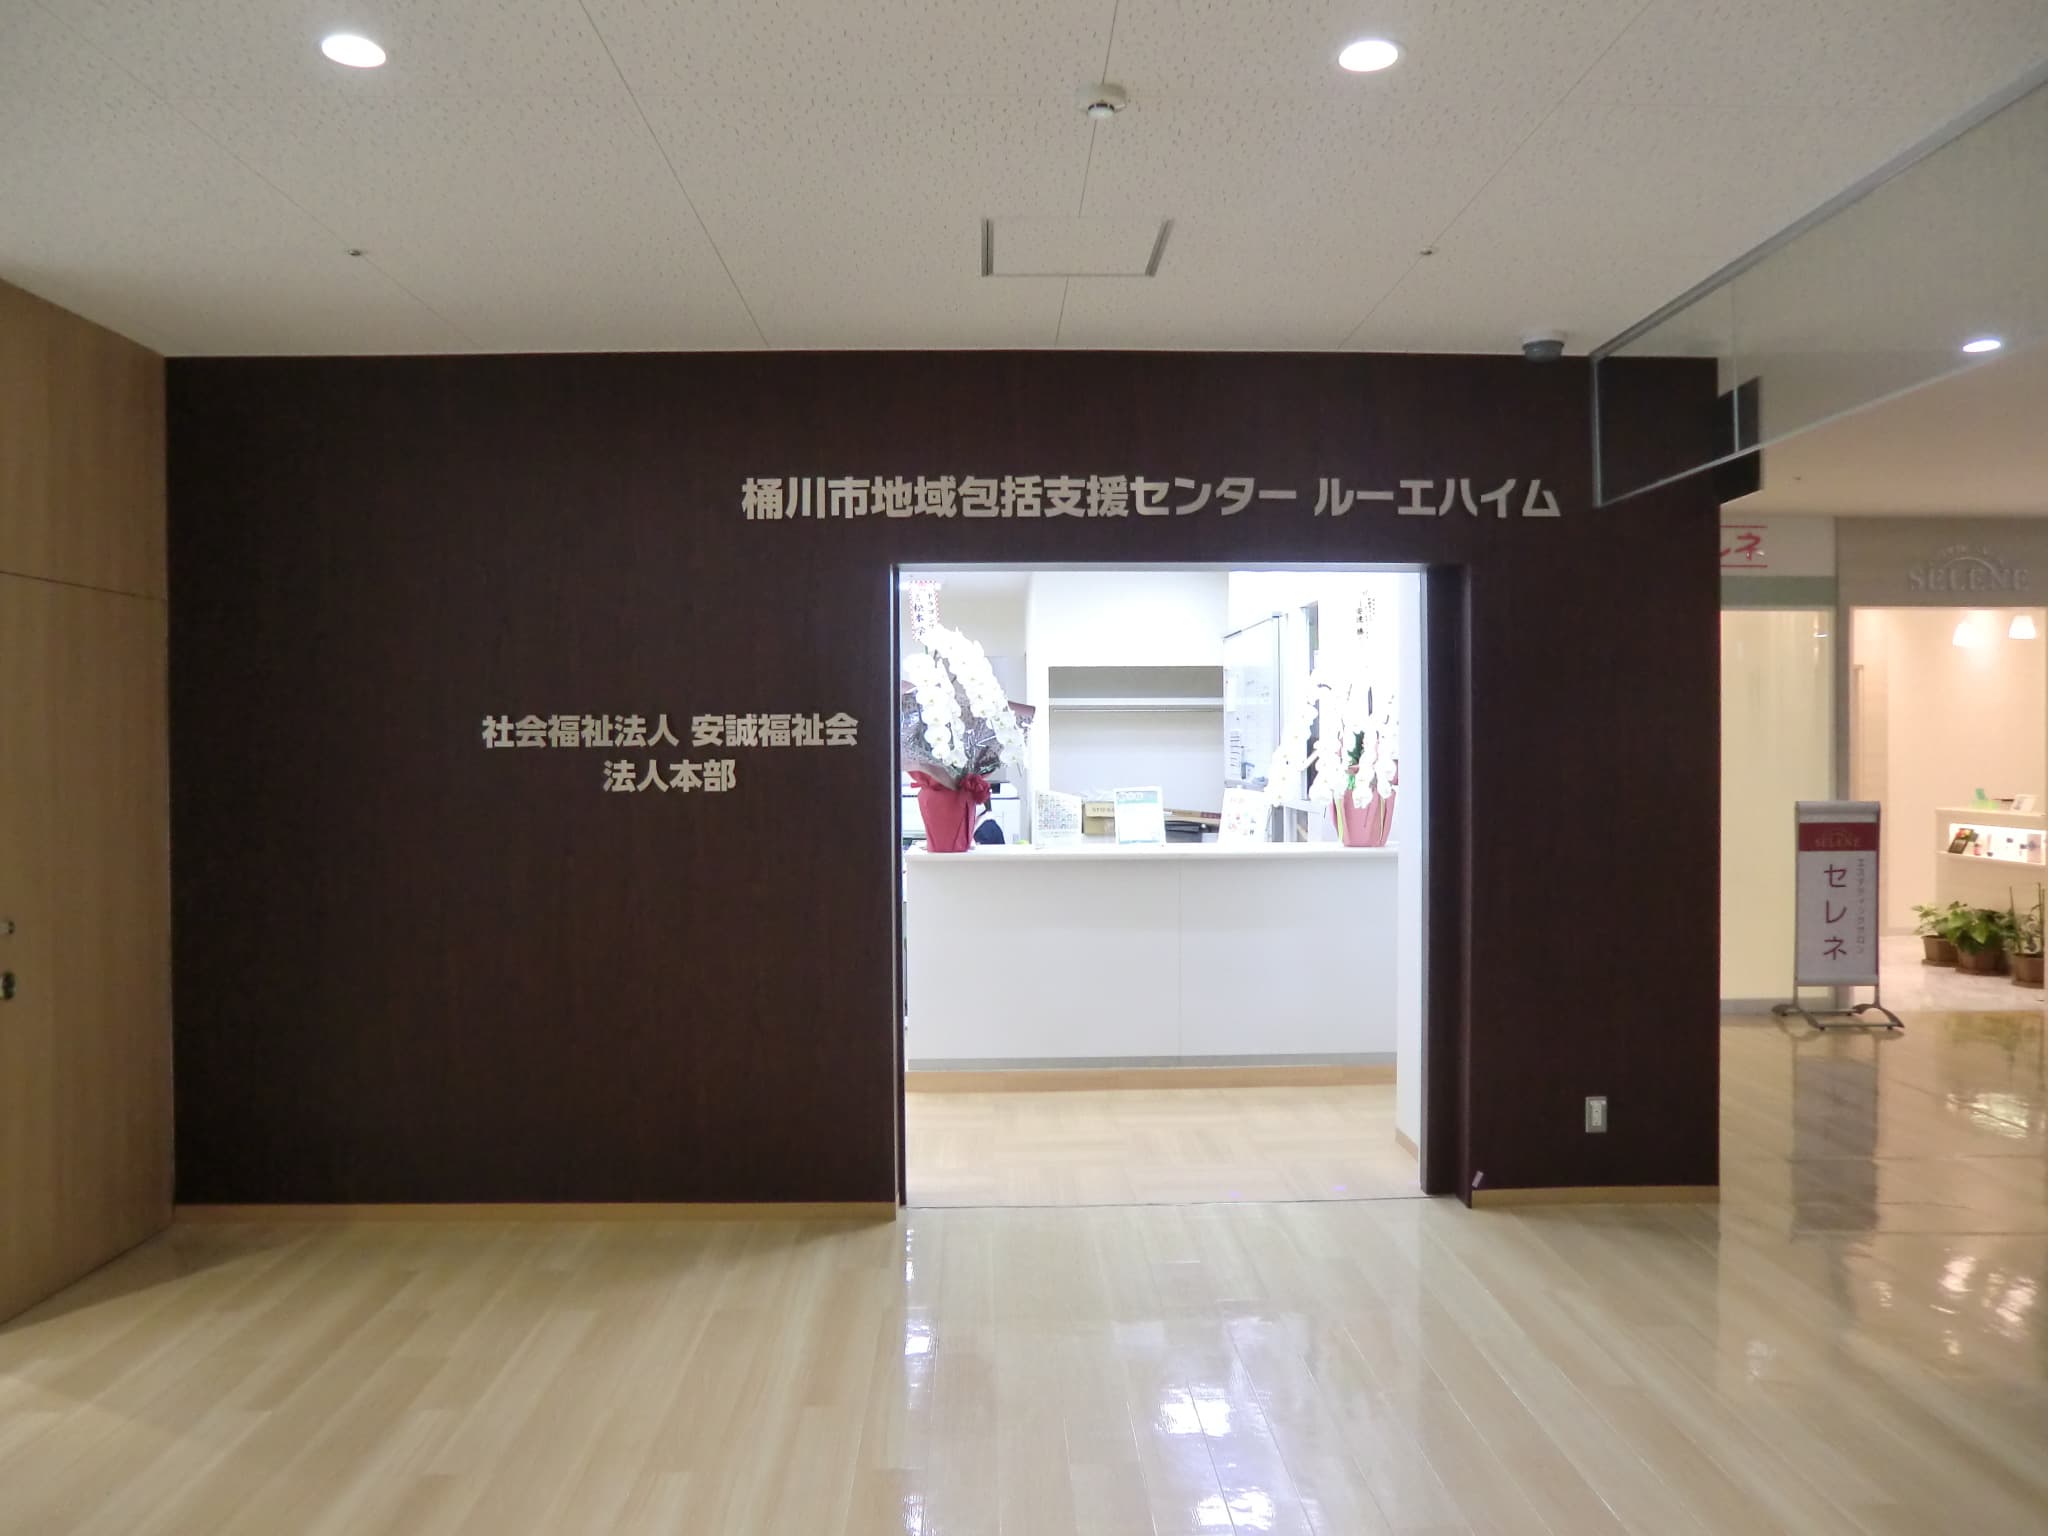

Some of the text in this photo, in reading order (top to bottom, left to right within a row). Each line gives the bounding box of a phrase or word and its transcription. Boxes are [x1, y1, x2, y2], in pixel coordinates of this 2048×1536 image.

[741, 475, 1561, 520] 桶川市地域包括支援センター ルーエハイム
[482, 712, 859, 749] 社会福祉法人 安誠福祉会
[603, 758, 738, 793] 法人本部
[1823, 863, 1848, 961] セレネ
